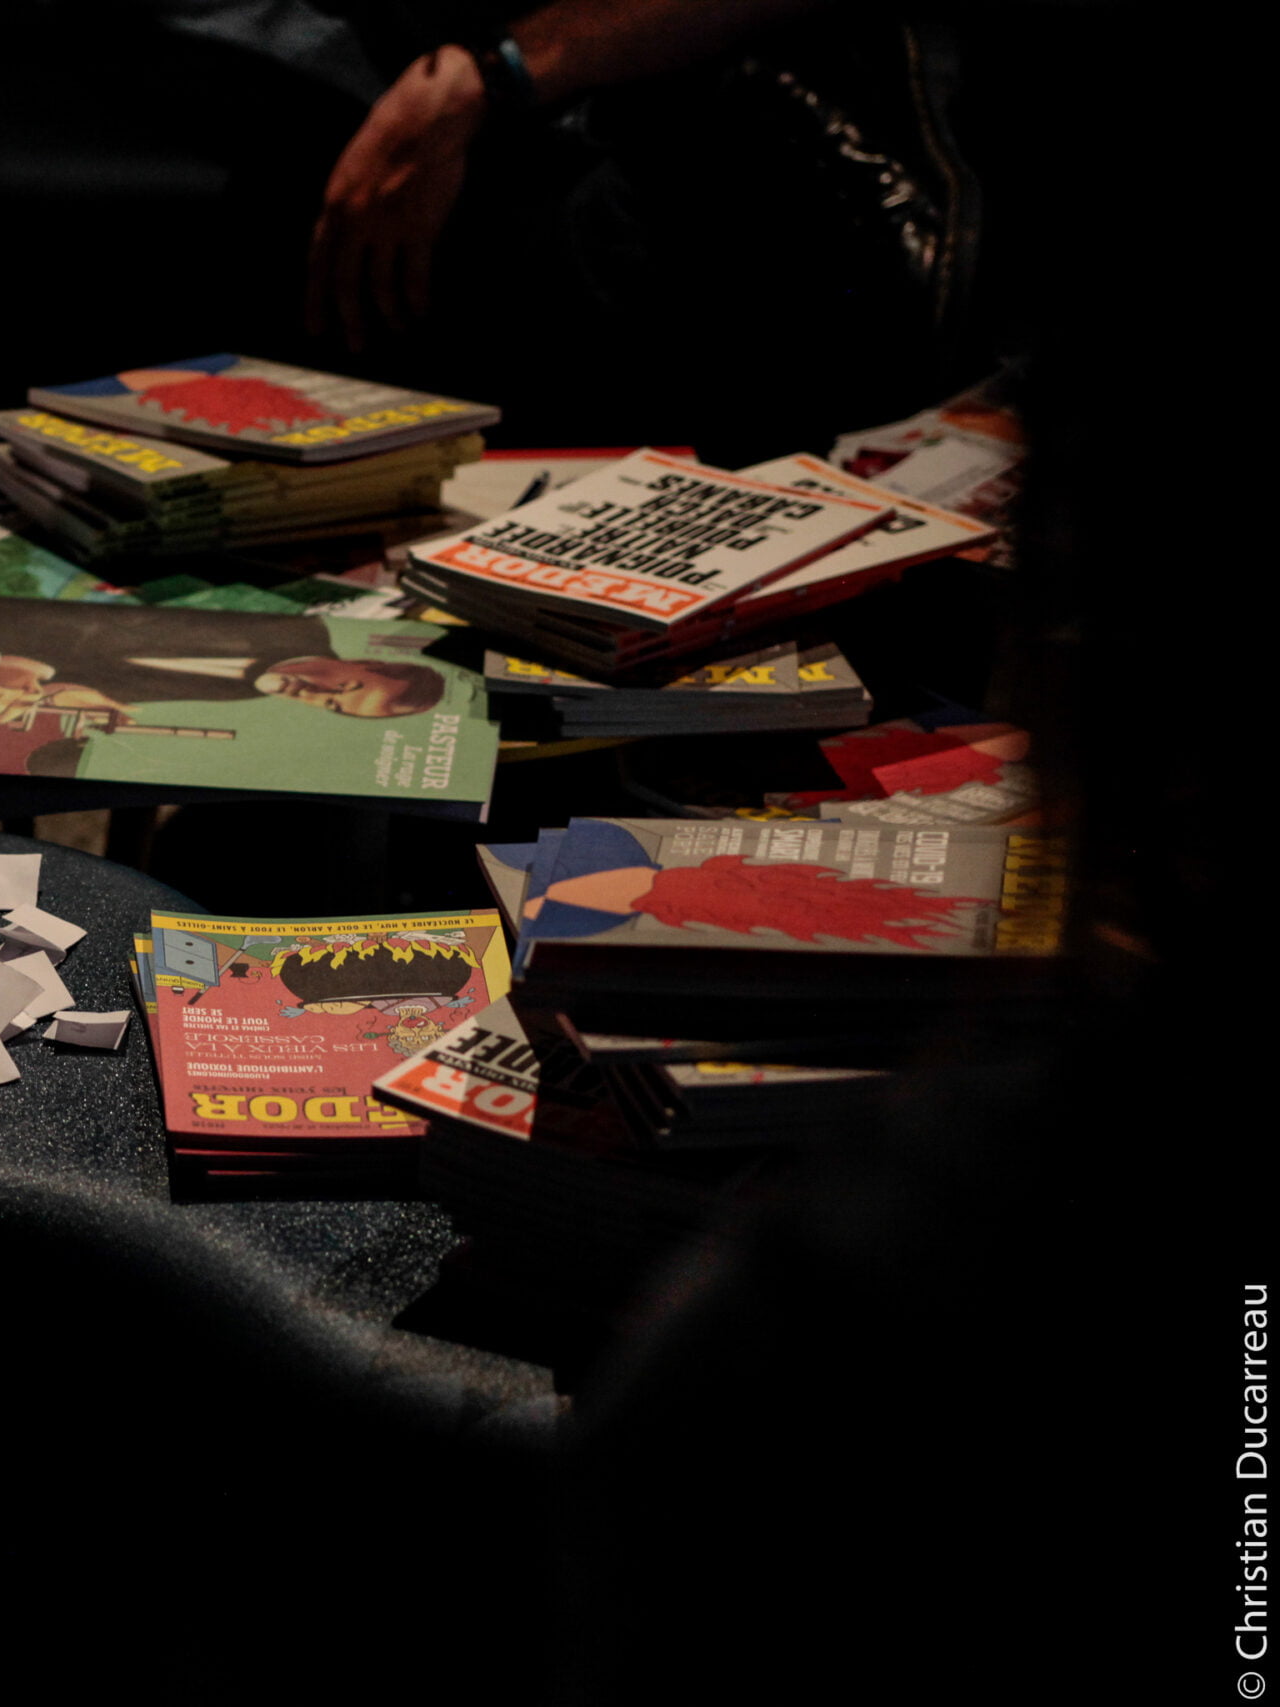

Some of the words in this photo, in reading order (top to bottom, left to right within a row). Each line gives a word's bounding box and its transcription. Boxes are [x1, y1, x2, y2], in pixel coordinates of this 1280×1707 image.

[646, 474, 824, 520] CABANES
[639, 494, 769, 531] DAECH
[579, 501, 768, 551] POUBELLE
[384, 730, 404, 744] de
[403, 744, 423, 762] La
[421, 713, 461, 790] PASTEUR
[394, 763, 417, 788] rage
[769, 828, 805, 861] SMART
[910, 831, 950, 884] COVID-19
[176, 921, 237, 932] SAINT-GILLES
[276, 925, 286, 933] LE
[182, 1006, 207, 1016] SERT
[210, 1007, 223, 1016] SE
[183, 1014, 223, 1023] MONDE
[226, 1016, 238, 1024] LE
[242, 1017, 269, 1025] TOUT
[183, 1032, 326, 1044] CASSEROLE
[184, 1041, 218, 1052] LA
[249, 1043, 329, 1053] VIEUX
[332, 1043, 379, 1053] LES
[447, 1026, 542, 1085] DEE
[186, 1063, 233, 1072] TOXIQUE
[237, 1064, 324, 1073] L'ANTIBIOTIQUE
[421, 1064, 535, 1123] OR
[192, 1092, 424, 1131] ÉDOR
